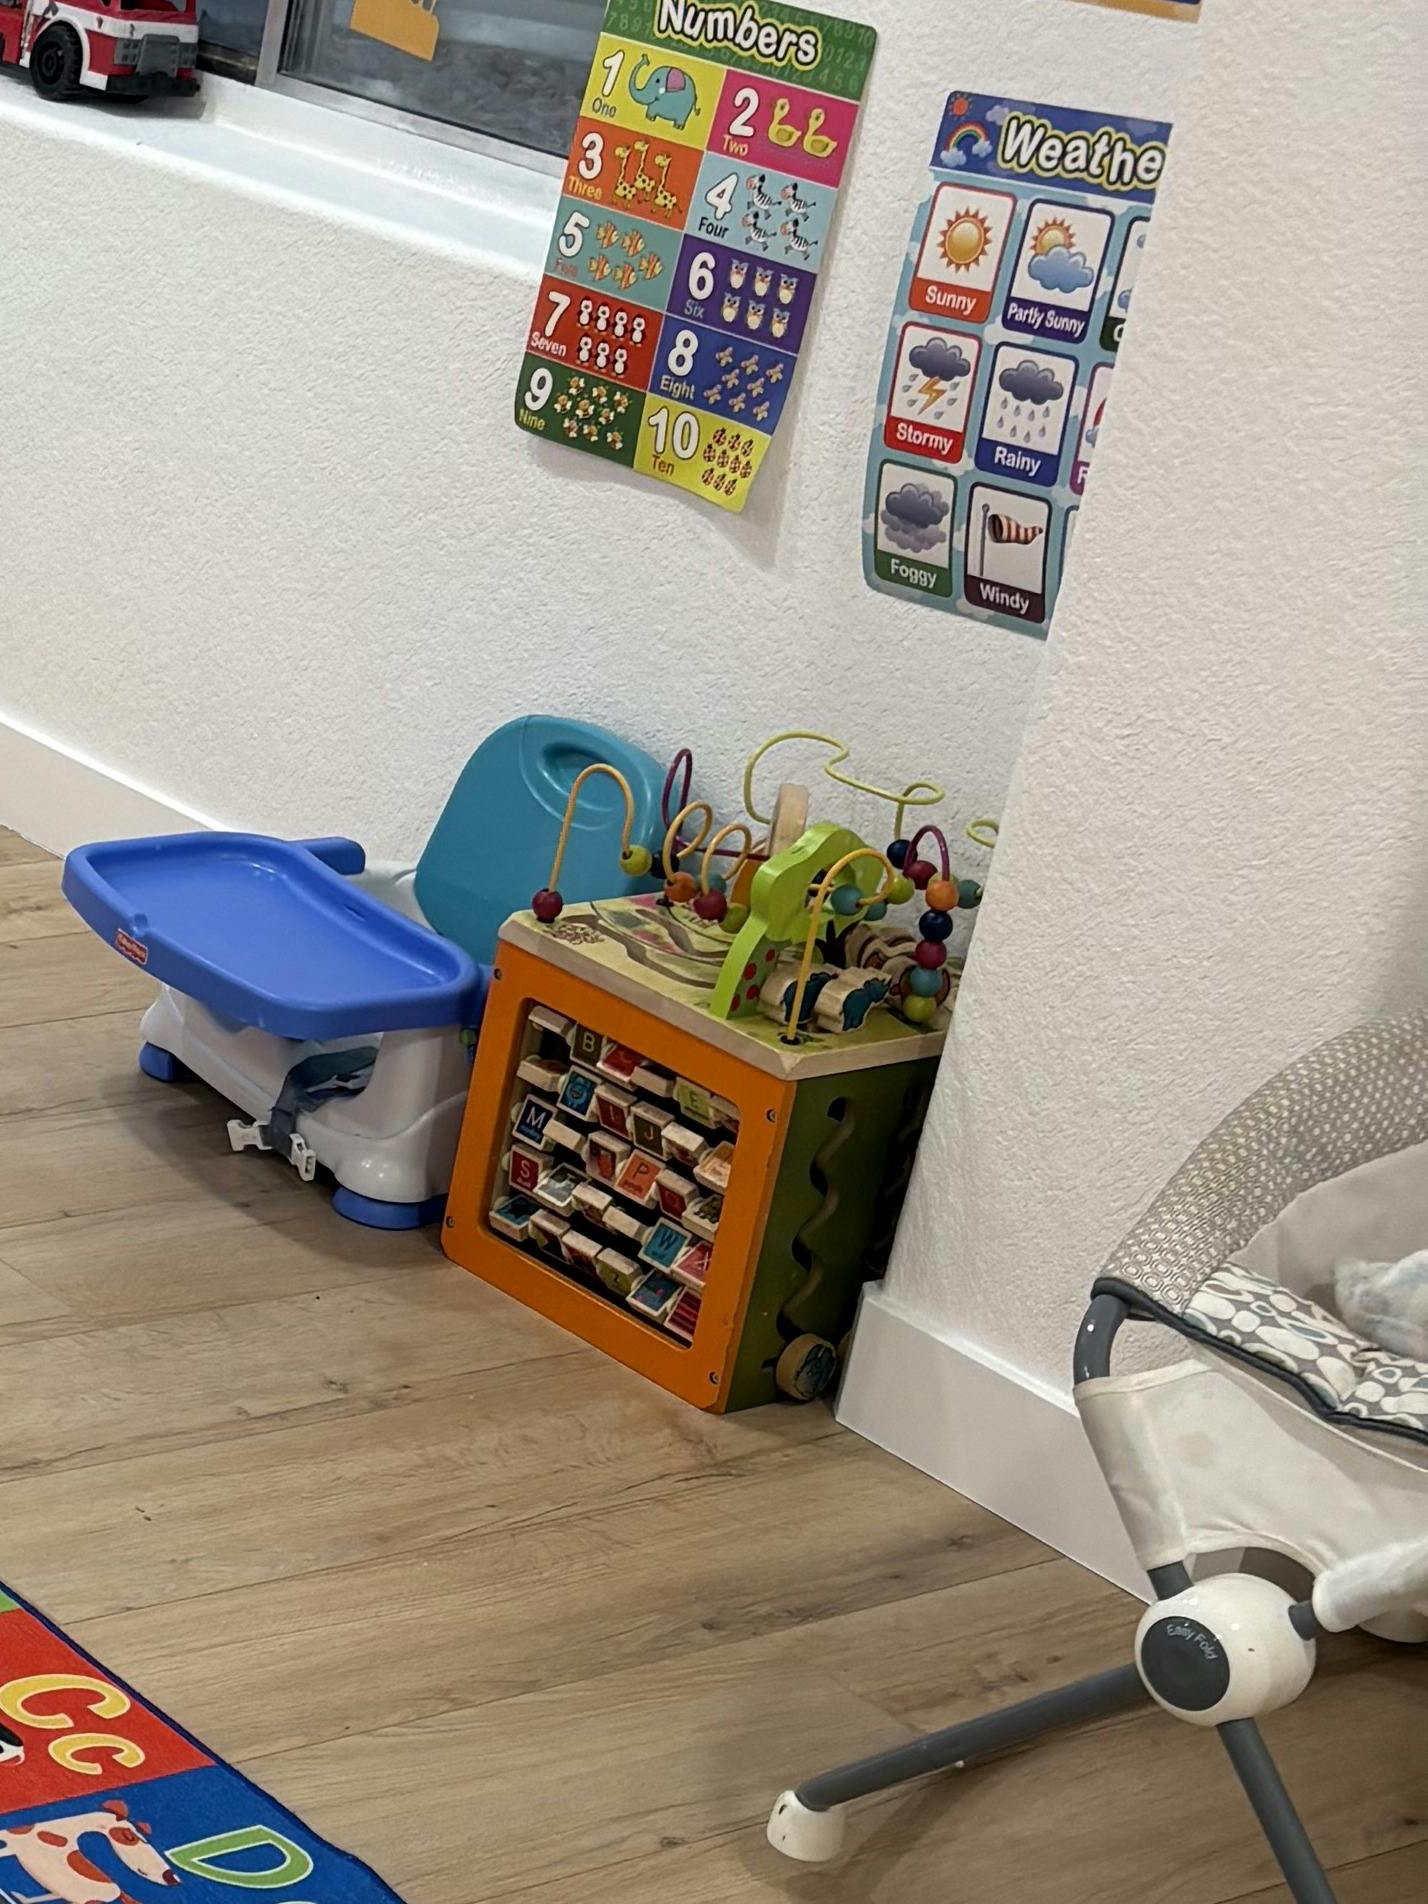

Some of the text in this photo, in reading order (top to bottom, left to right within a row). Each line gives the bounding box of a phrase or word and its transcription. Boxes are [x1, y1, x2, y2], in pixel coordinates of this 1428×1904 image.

[729, 87, 759, 137] 2
[578, 132, 604, 179] 3
[723, 133, 749, 156] Two
[1003, 116, 1165, 184] Weathe
[567, 175, 602, 199] Three
[705, 172, 739, 220] 4
[698, 216, 730, 238] Four
[925, 286, 976, 315] Sunny
[1007, 303, 1043, 329] Partly
[1046, 310, 1086, 338] Sunny
[529, 333, 567, 357] Seven
[660, 375, 695, 400] Eight
[648, 406, 700, 460] 10
[896, 422, 953, 455] Stormy
[651, 455, 675, 475] Ten
[994, 448, 1041, 476] Rainy
[890, 559, 937, 587] Foggy
[980, 583, 1030, 614] Windy
[527, 1106, 546, 1128] M
